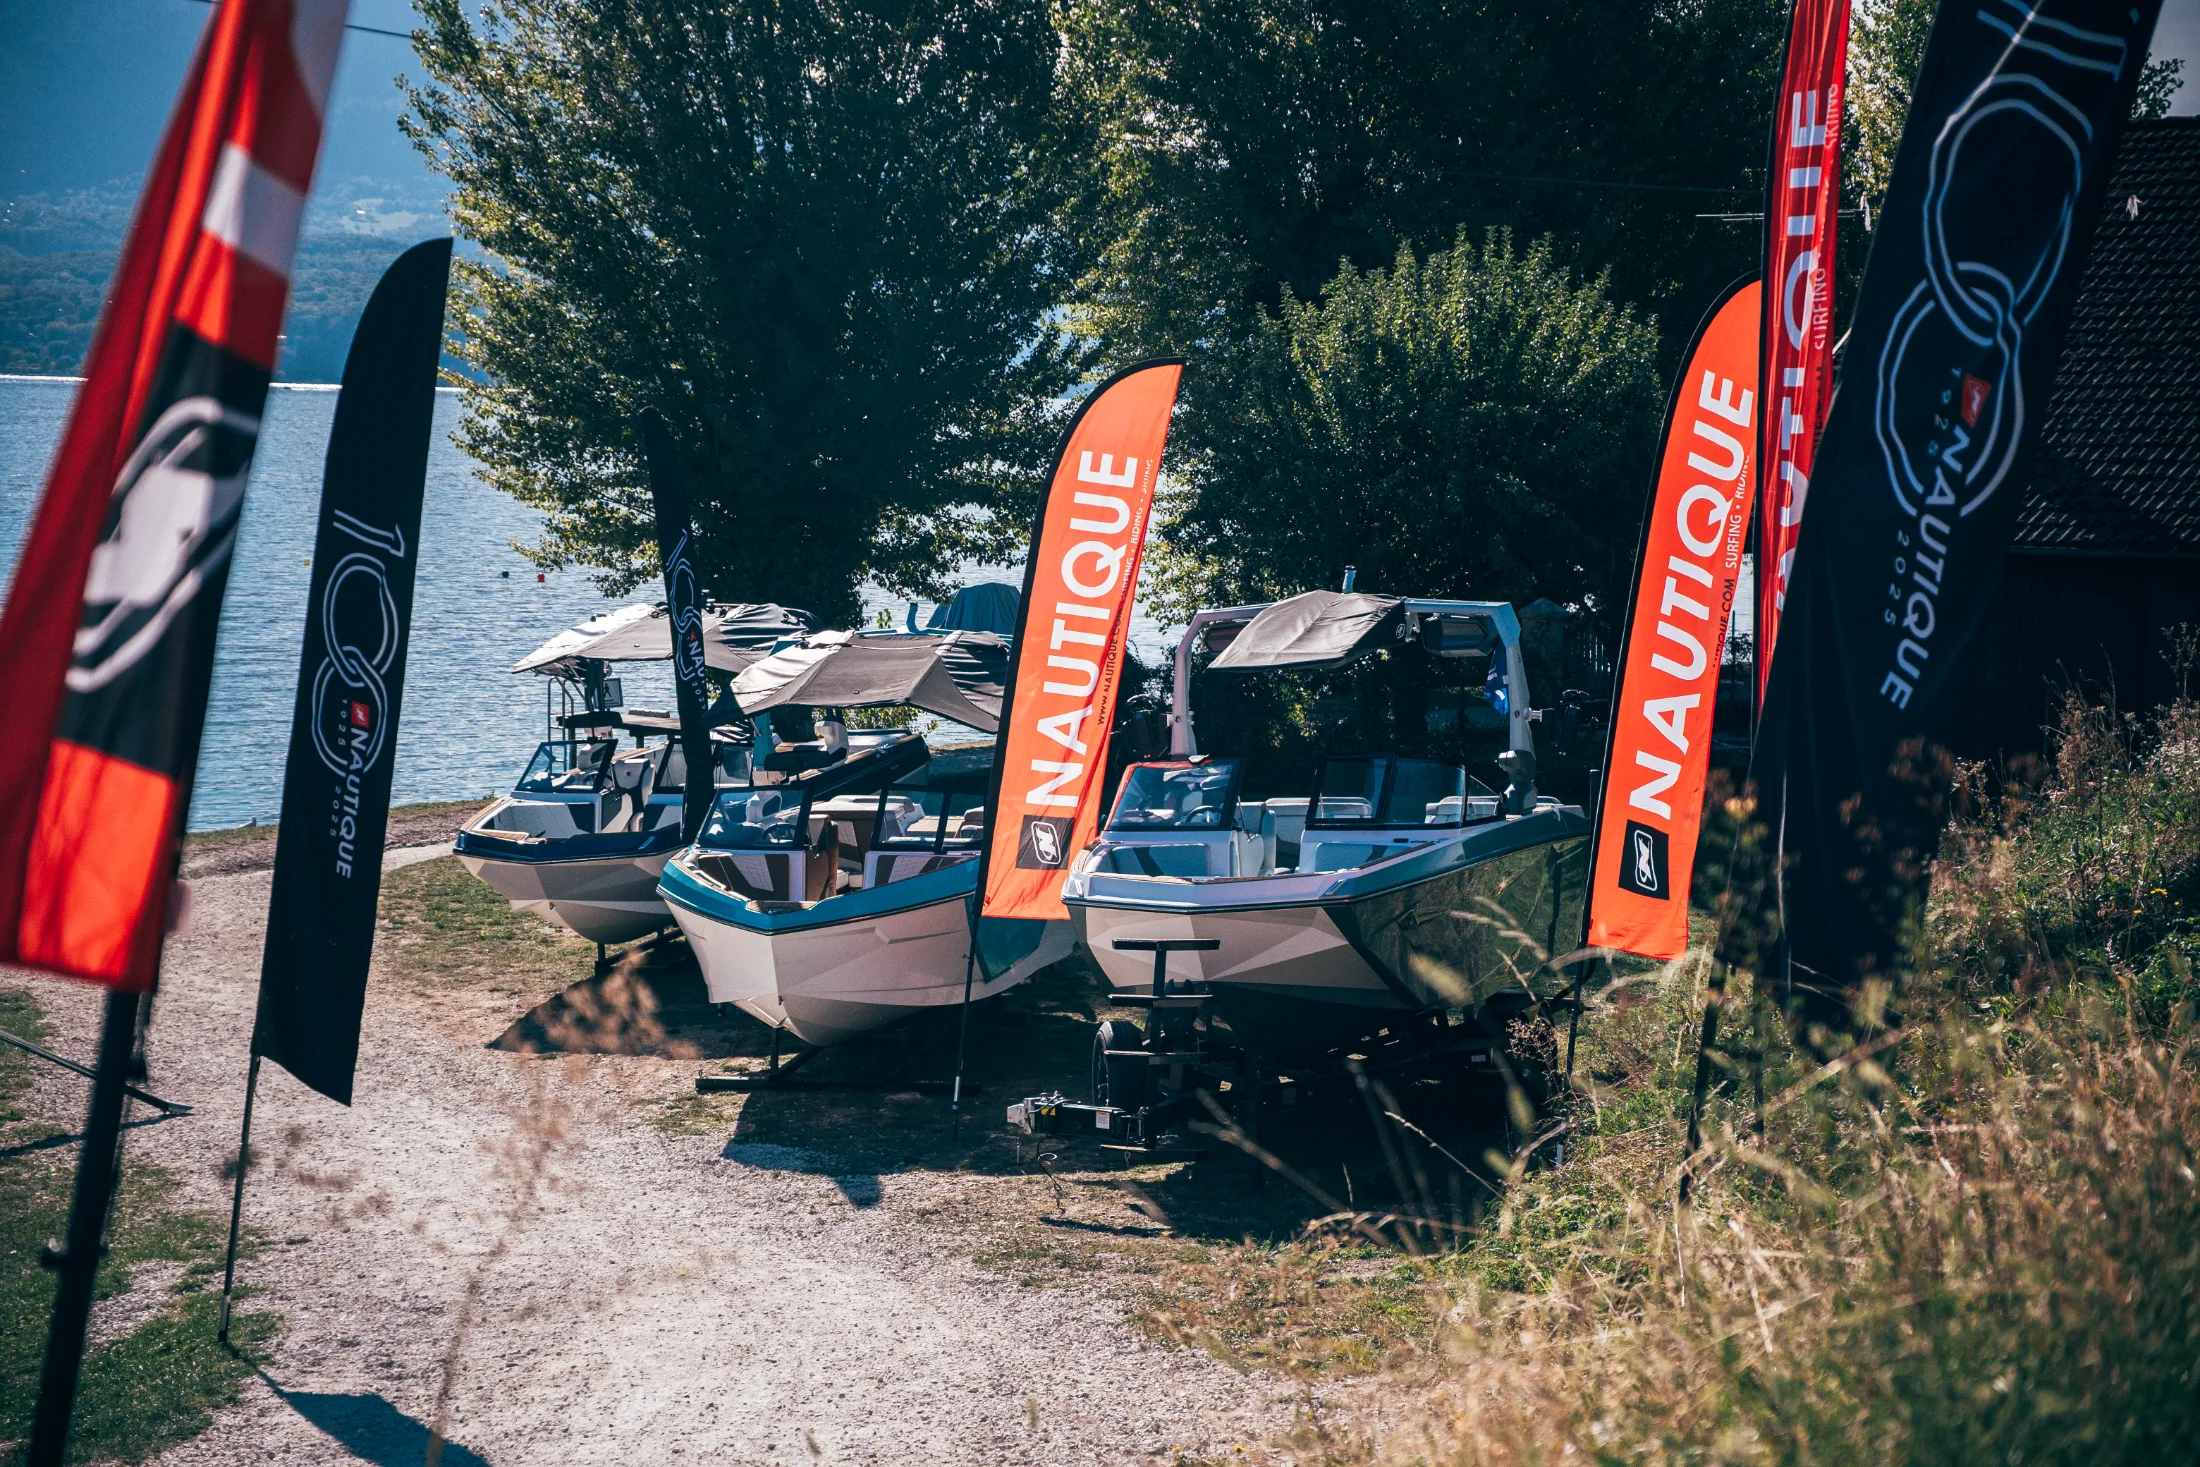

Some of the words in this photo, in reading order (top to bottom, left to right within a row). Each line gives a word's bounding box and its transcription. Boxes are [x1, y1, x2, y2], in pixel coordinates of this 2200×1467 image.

[1130, 507, 1143, 544] RIDING
[1725, 514, 1742, 569] SURFING
[1879, 424, 1971, 711] NAUTIQUE
[1629, 370, 1754, 821] NAUTIQUE
[1884, 530, 1911, 626] 2025
[1025, 450, 1139, 808] NAUTIQUE
[337, 699, 348, 747] 1925
[329, 785, 342, 837] 2025
[335, 727, 370, 879] NAUTIQUE
